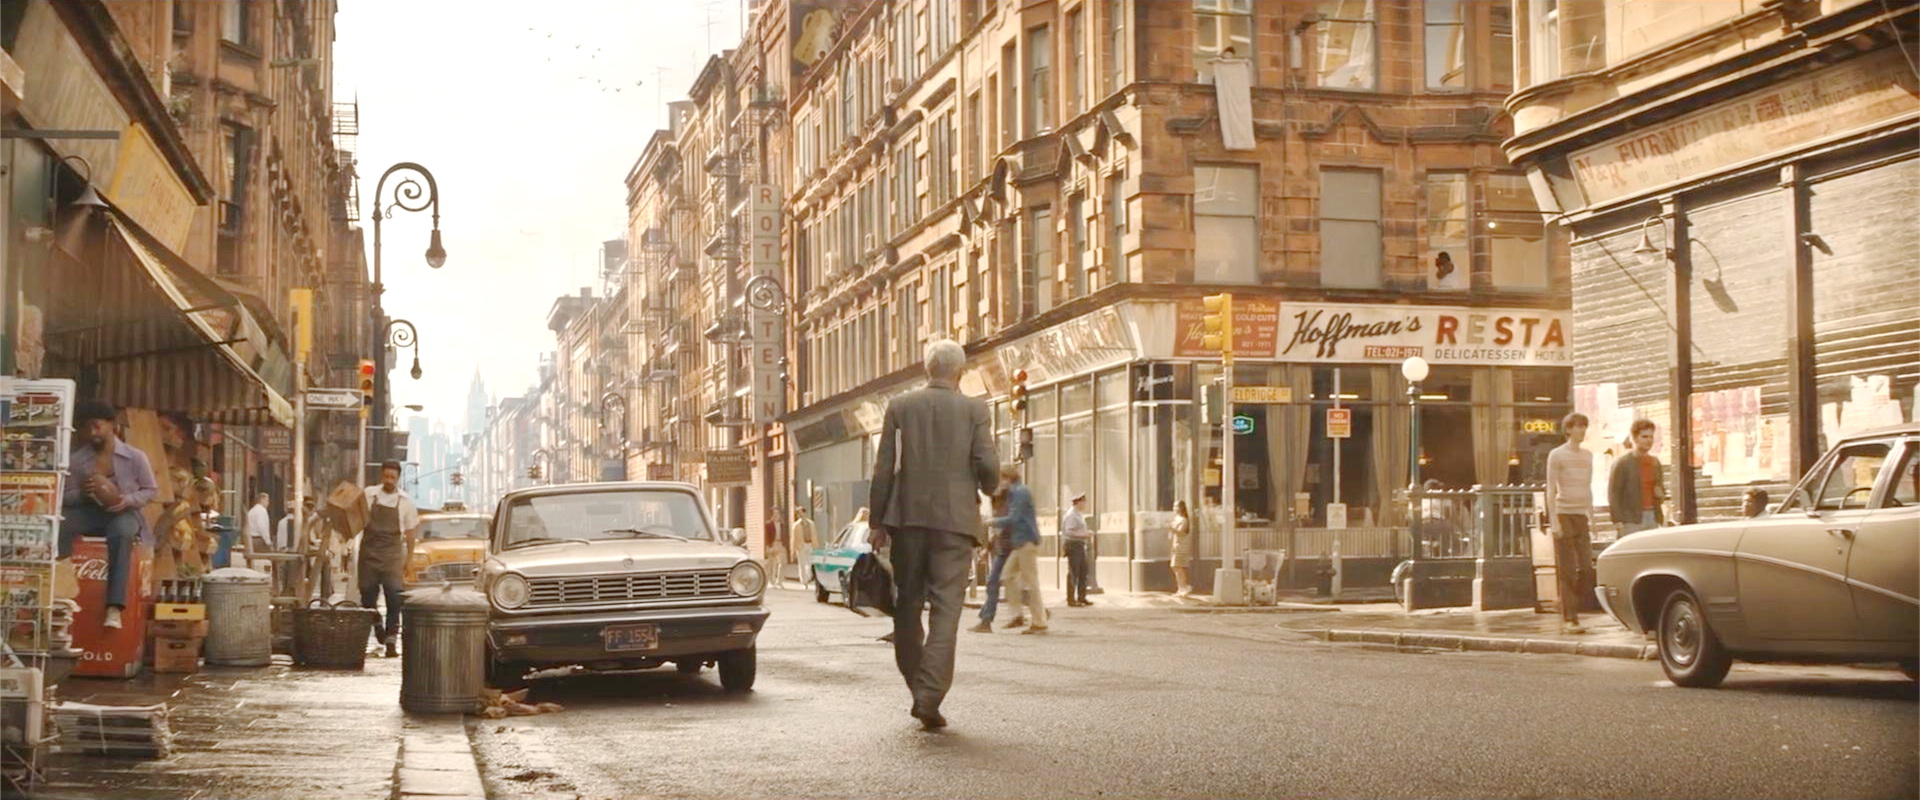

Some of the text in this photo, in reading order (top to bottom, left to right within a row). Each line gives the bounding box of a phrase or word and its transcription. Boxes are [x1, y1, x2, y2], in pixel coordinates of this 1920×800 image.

[760, 188, 776, 416] ROTHTEIN
[1282, 310, 1422, 358] Hoffman's
[1435, 349, 1526, 360] DELICATESSEN
[309, 395, 345, 403] ONE WAY
[1234, 388, 1277, 401] ELDRIDGE
[1524, 420, 1557, 434] OPEN
